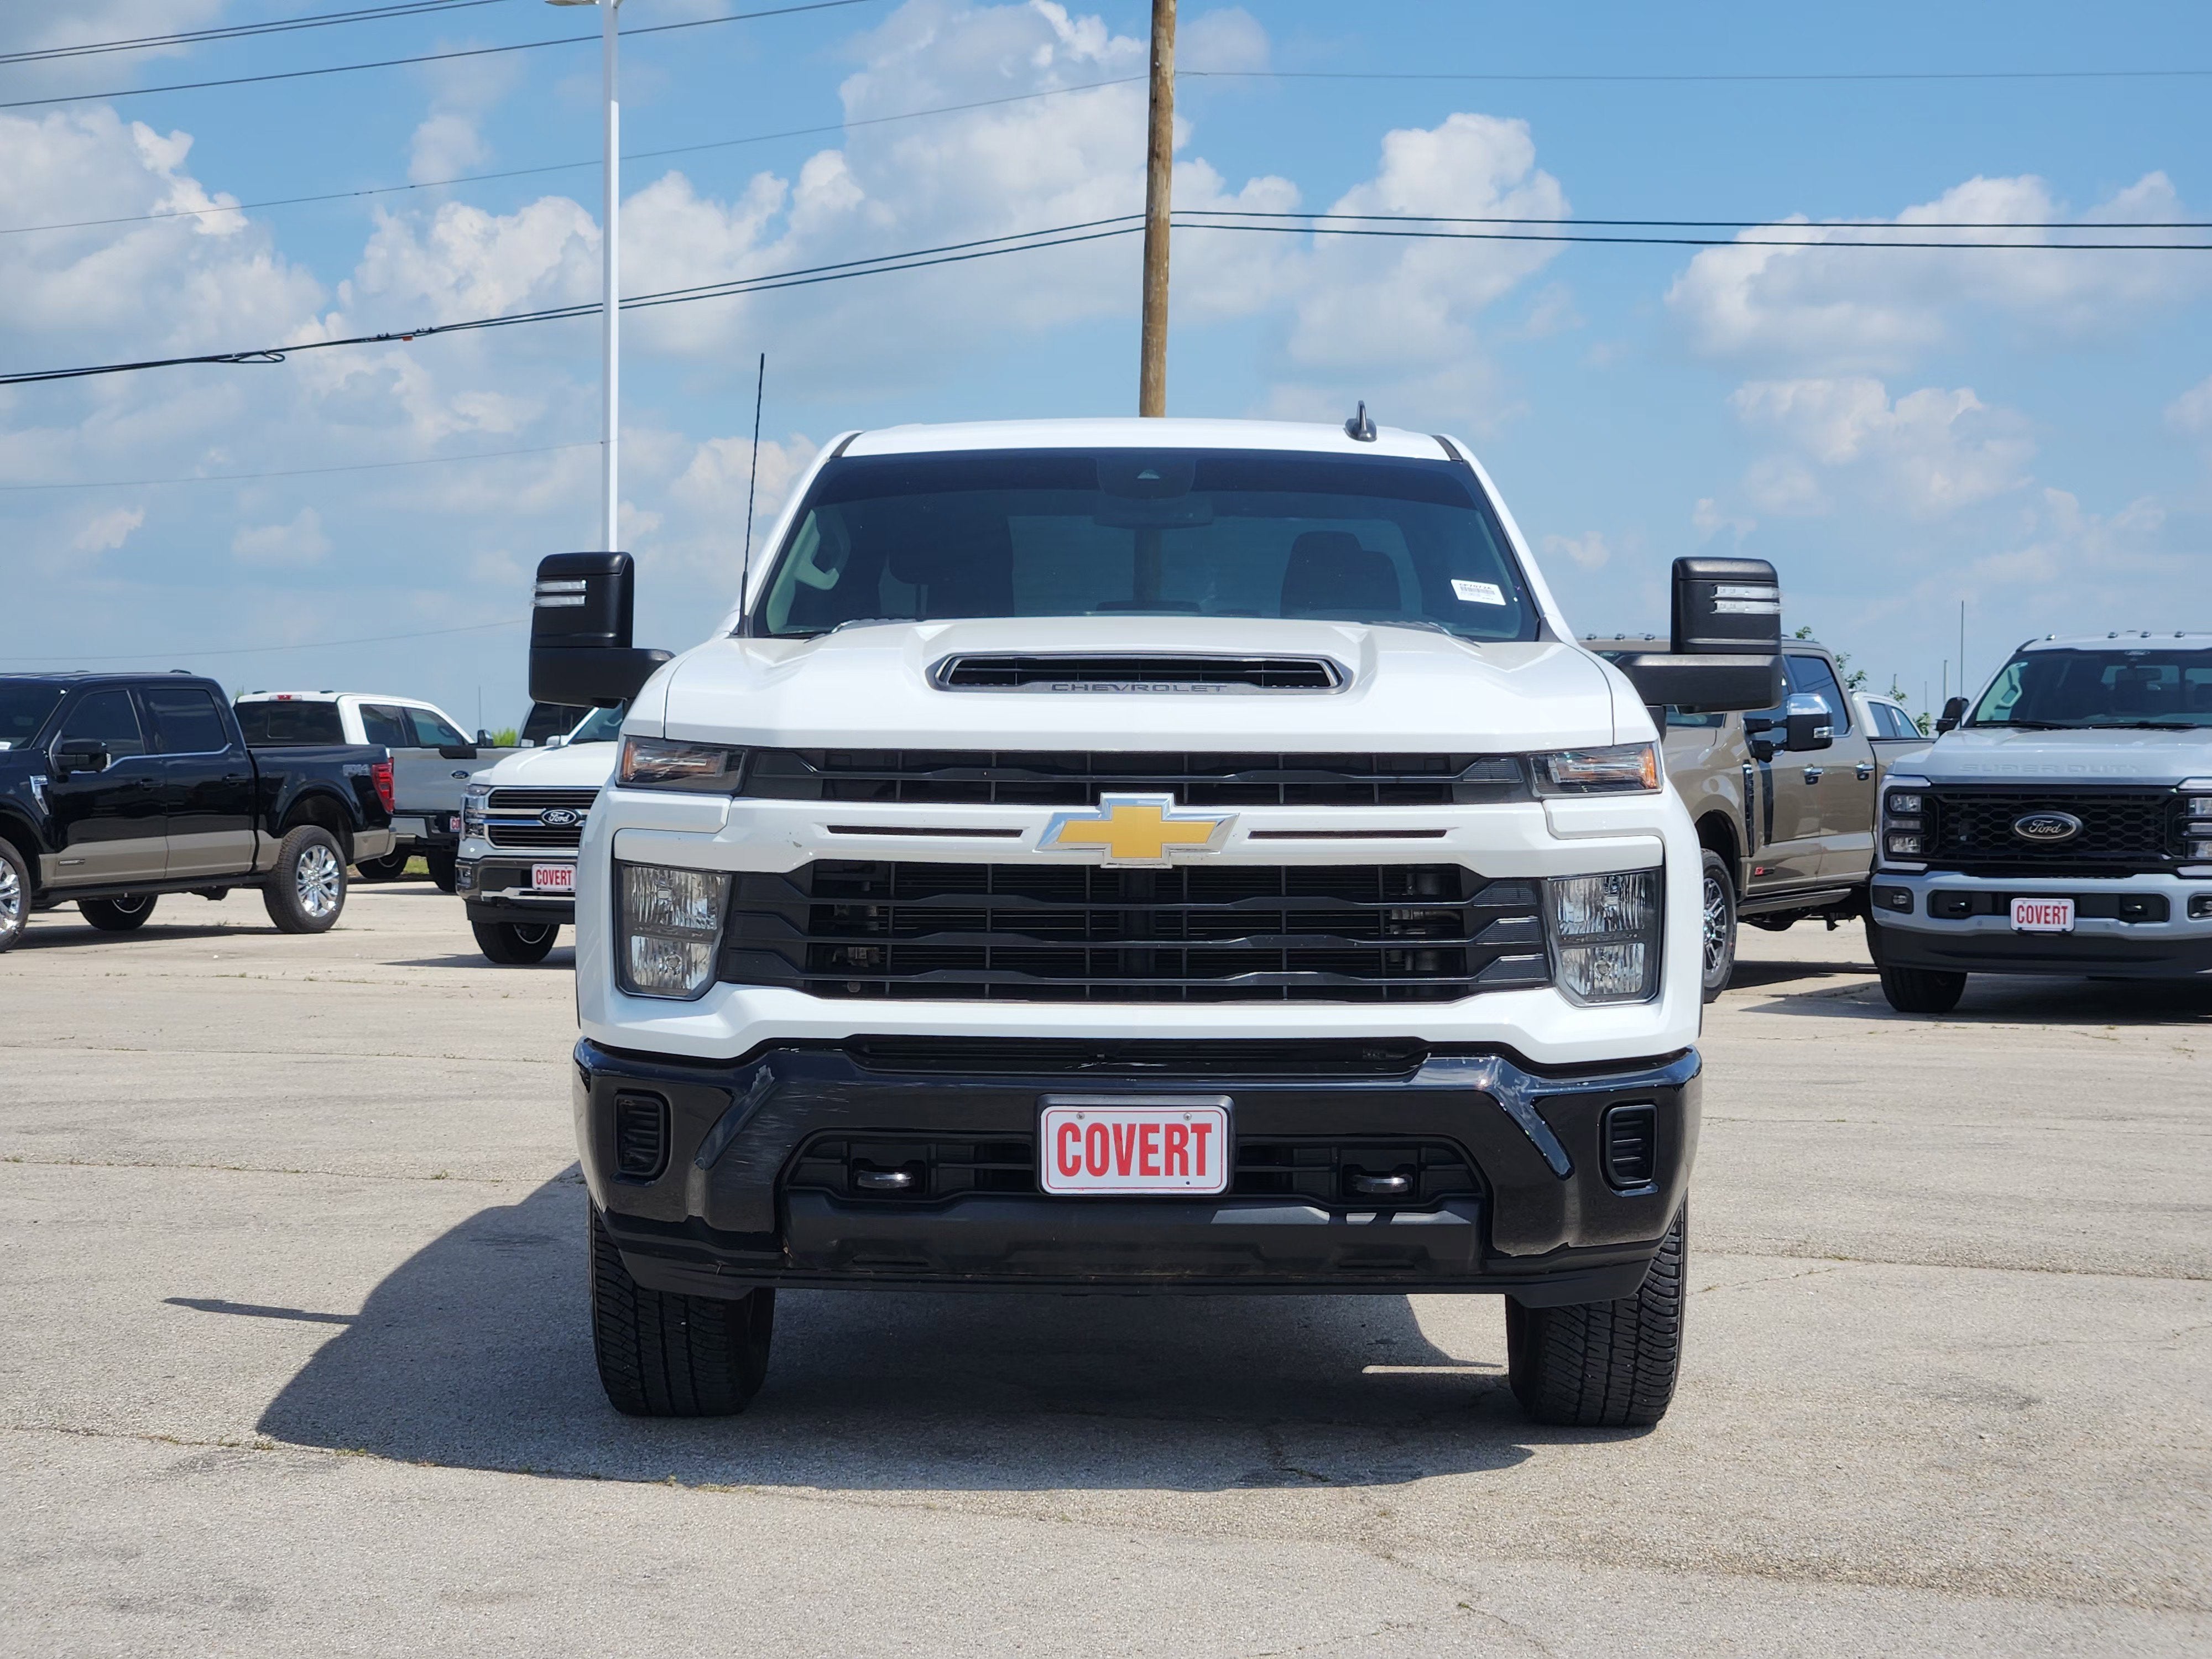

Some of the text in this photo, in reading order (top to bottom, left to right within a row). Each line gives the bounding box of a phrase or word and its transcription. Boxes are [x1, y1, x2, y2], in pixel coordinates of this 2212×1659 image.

[1051, 683, 1228, 692] CHEVROLET
[548, 811, 570, 822] Ford
[2029, 820, 2062, 833] Ford
[536, 869, 572, 885] COVERT
[2017, 905, 2068, 925] COVERT
[1057, 1122, 1212, 1177] COVERT
